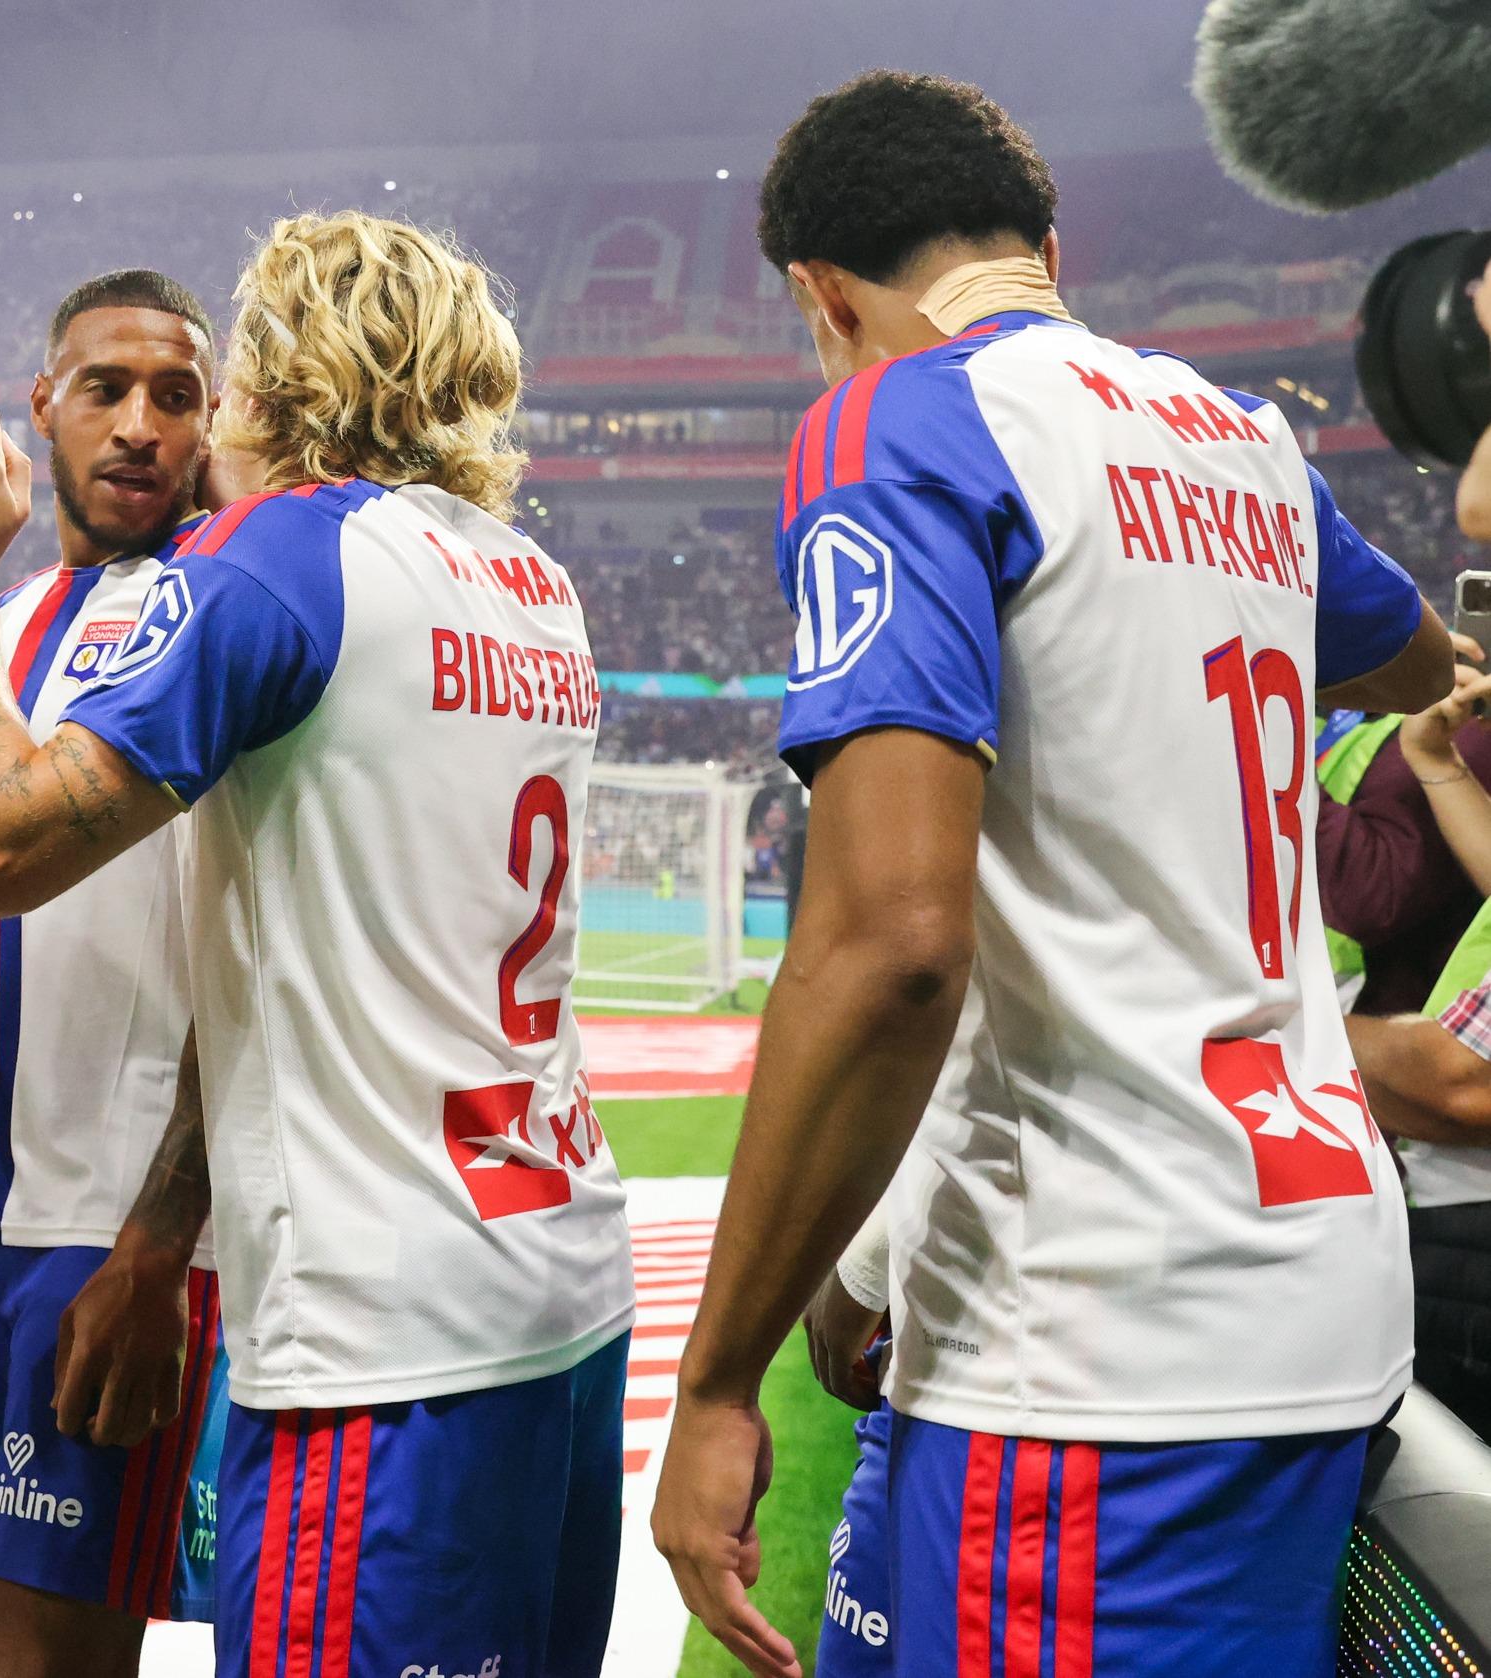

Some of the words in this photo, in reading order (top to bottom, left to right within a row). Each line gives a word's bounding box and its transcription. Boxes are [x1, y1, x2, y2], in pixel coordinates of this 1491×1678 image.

[1064, 360, 1270, 444] WMAX
[423, 531, 573, 607] WMAX
[1202, 635, 1305, 979] 13
[498, 775, 568, 1047] 2
